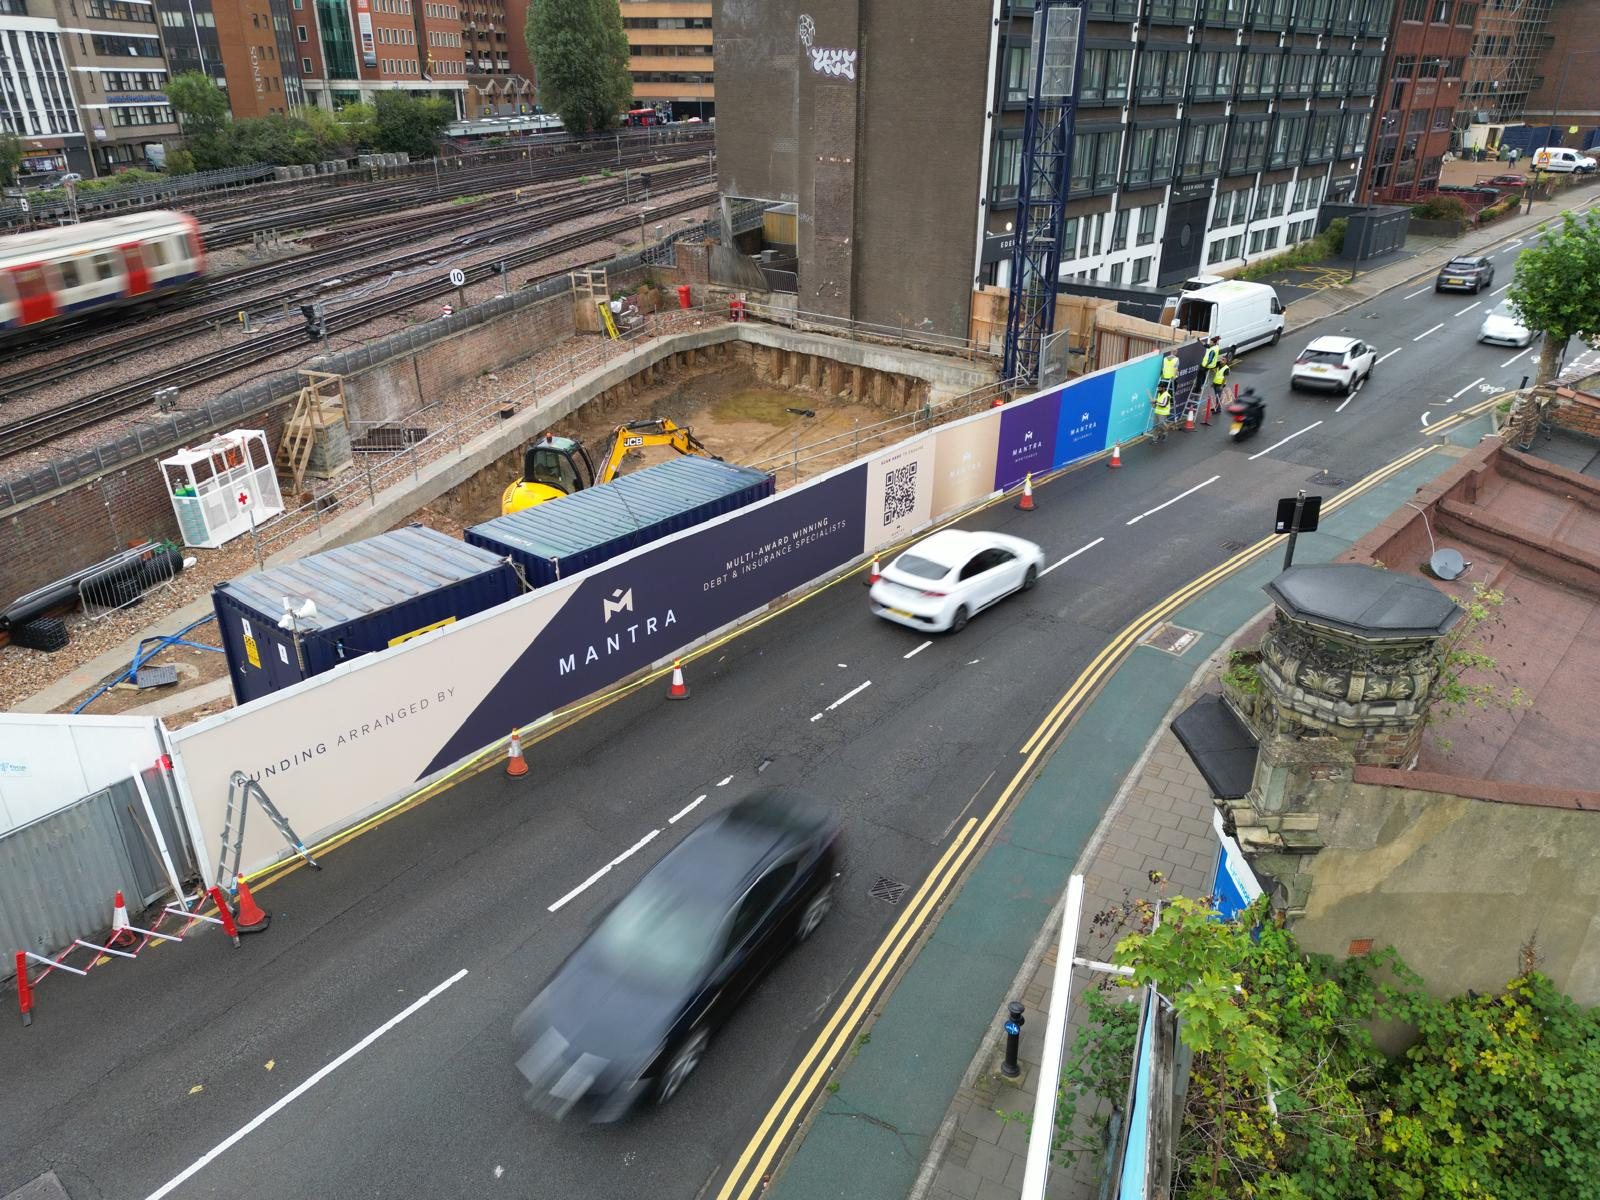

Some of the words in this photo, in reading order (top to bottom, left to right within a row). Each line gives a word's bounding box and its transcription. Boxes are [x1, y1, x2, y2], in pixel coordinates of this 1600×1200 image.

[452, 272, 463, 282] 10
[624, 437, 643, 446] JCB
[1070, 421, 1097, 436] MANTRA
[1012, 441, 1042, 456] MANTRA
[703, 574, 728, 591] DEBT
[732, 570, 738, 578] &
[742, 544, 792, 574] INSURANCE
[795, 519, 847, 549] SPECIALISTS
[726, 536, 789, 571] MULTI-AWARD
[792, 517, 829, 540] WINNING
[559, 609, 677, 676] MANTRA
[336, 698, 430, 747] ARRANGED
[437, 686, 456, 702] BY
